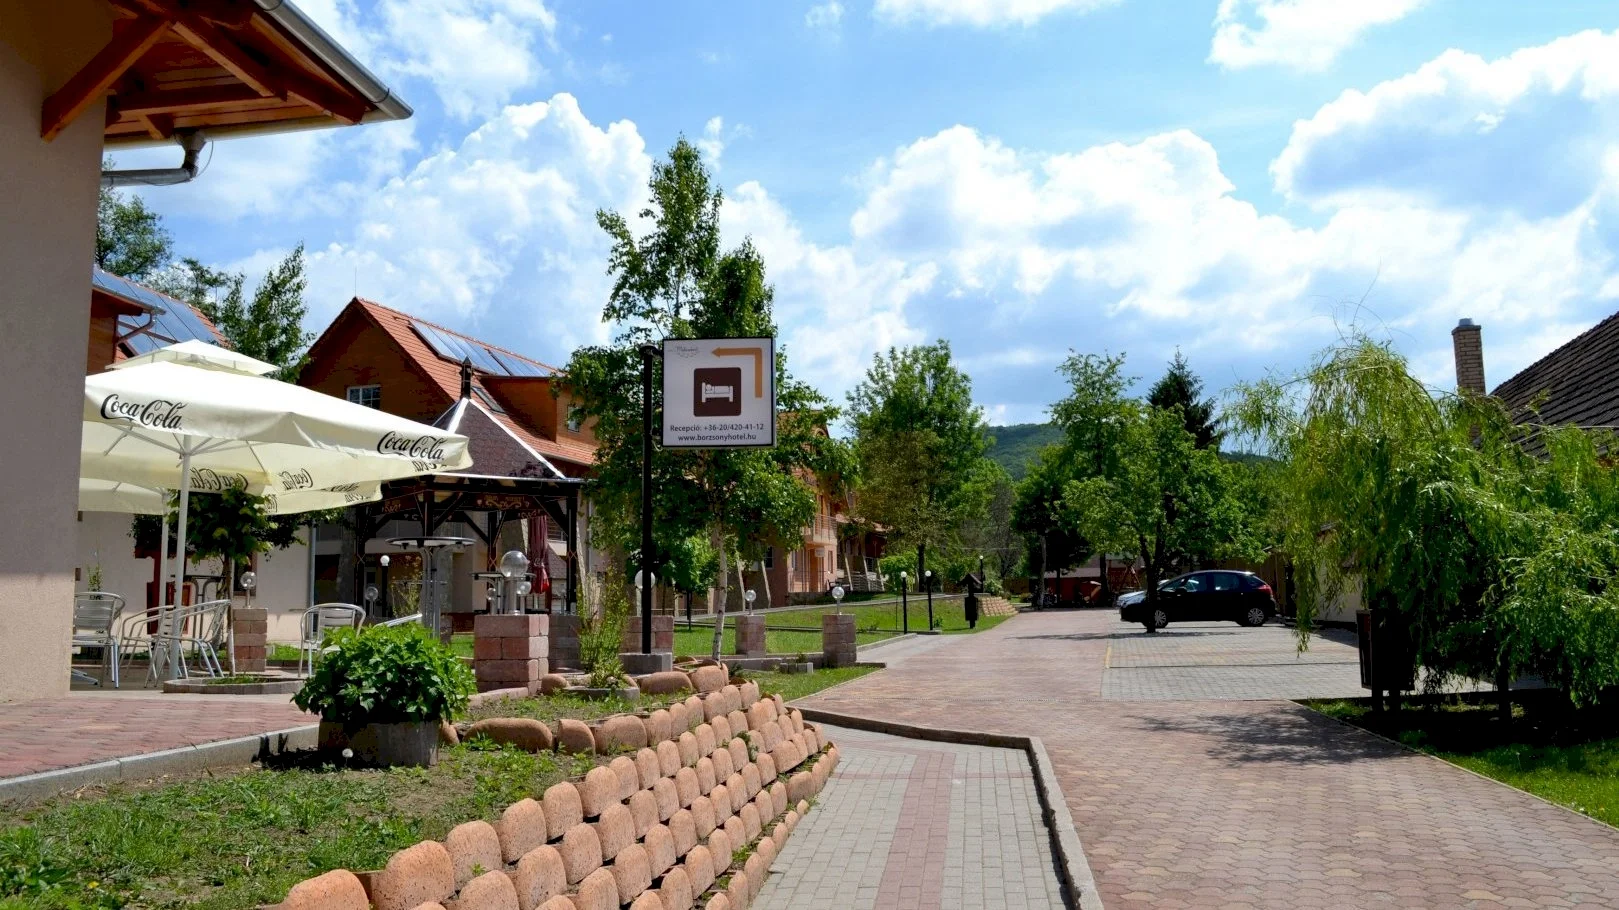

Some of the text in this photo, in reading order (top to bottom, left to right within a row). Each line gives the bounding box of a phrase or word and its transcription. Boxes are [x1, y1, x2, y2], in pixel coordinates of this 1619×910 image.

[670, 423, 764, 433] Recepció: +36-20/420-41-12
[678, 433, 757, 442] www.borzsonyhotel.hu
